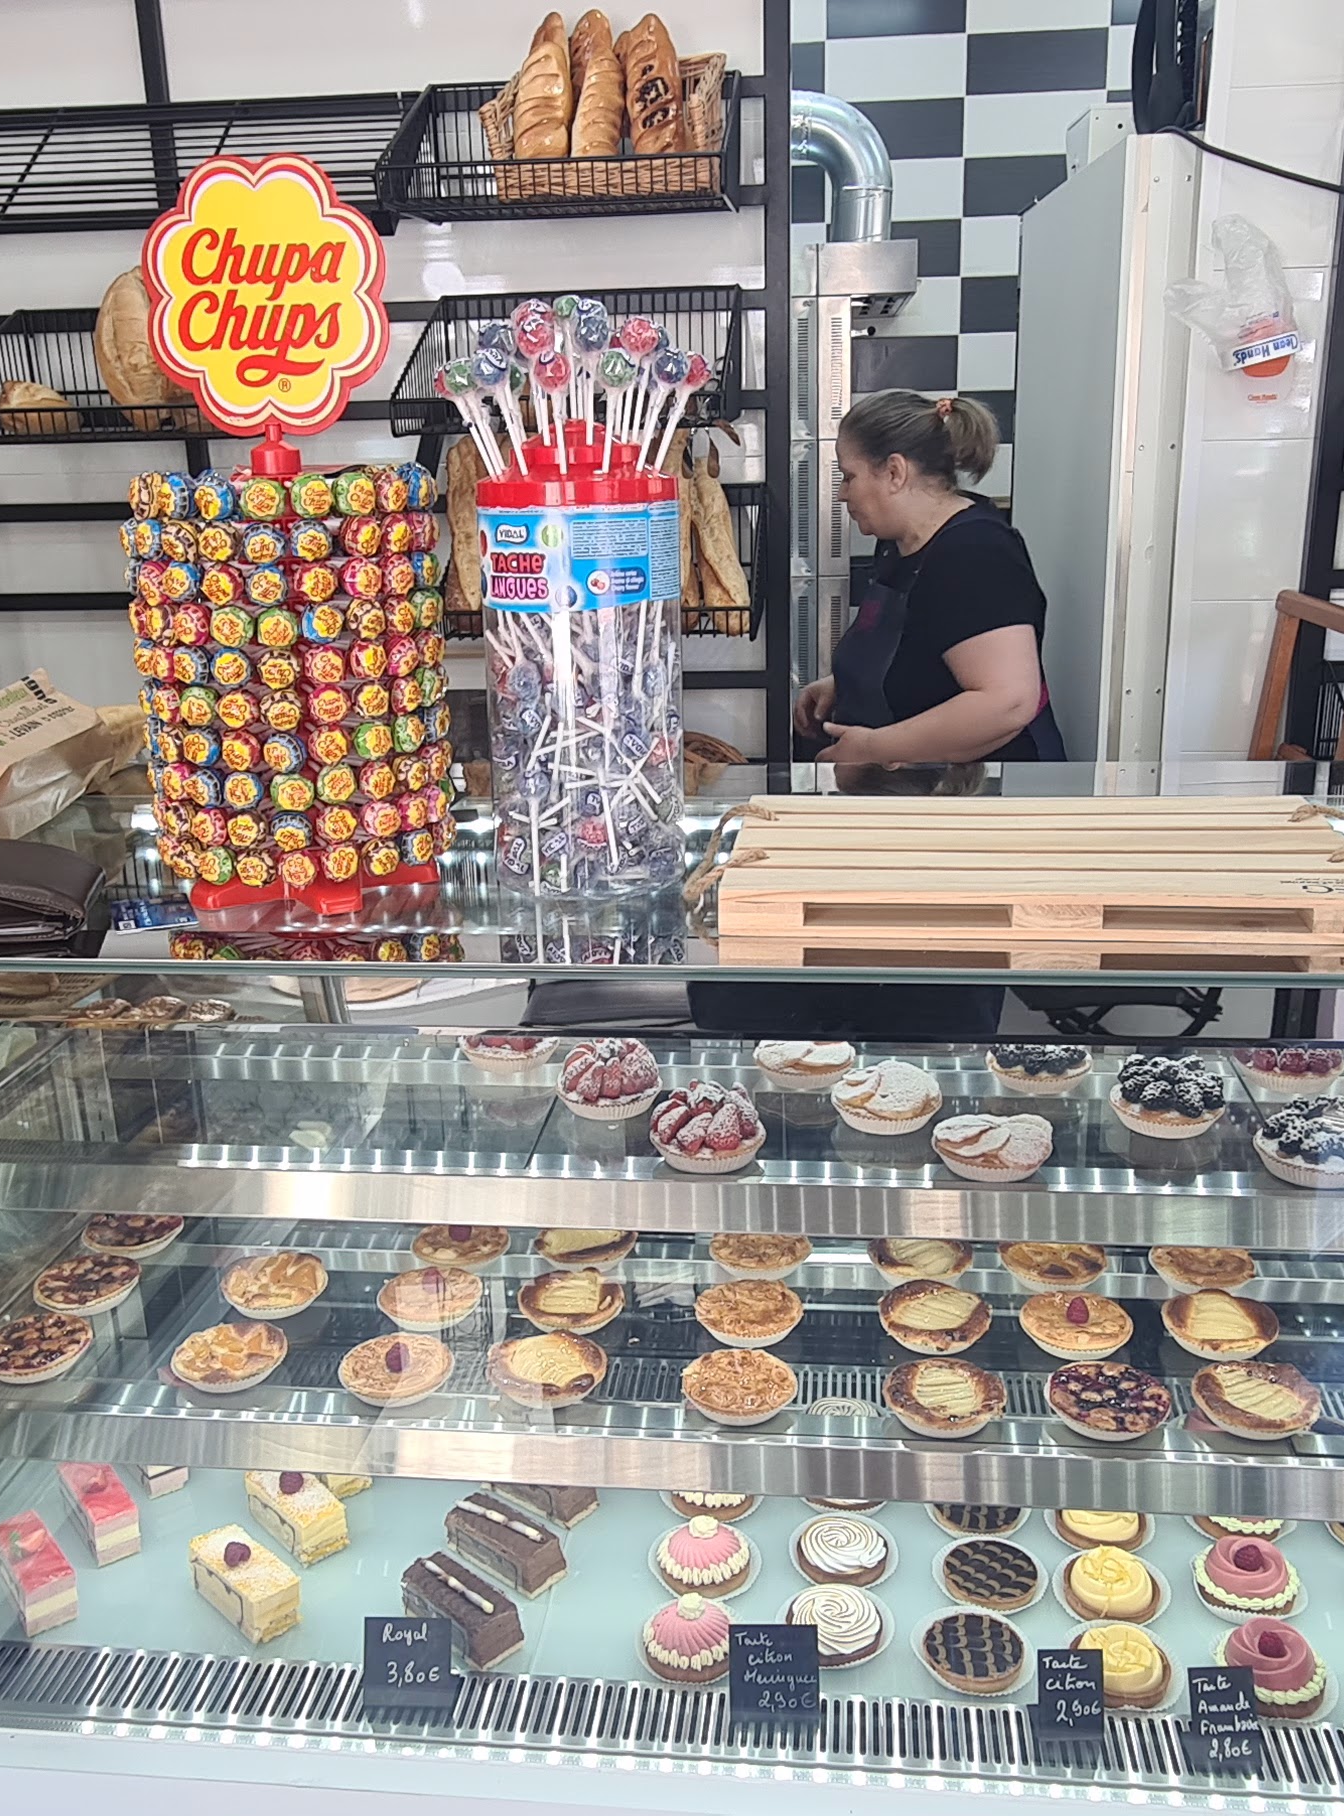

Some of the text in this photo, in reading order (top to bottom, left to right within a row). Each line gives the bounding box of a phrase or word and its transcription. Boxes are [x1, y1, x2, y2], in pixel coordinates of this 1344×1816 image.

[181, 227, 347, 301] Chupa
[178, 289, 344, 387] Chups
[1234, 334, 1298, 366] Clean Hands
[498, 528, 525, 539] VIDAL
[490, 552, 546, 574] TACHE
[490, 575, 549, 600] LANGUES
[382, 1622, 428, 1646] Royal
[734, 1631, 774, 1646] Tarte
[1042, 1654, 1089, 1669] Tarte
[386, 1660, 440, 1688] 3,80€
[1191, 1674, 1232, 1694] Tarte
[758, 1690, 817, 1713] 2,90€
[1056, 1698, 1102, 1727] 2,90€
[1197, 1690, 1251, 1714] Amande
[1209, 1736, 1253, 1763] 2,80€
